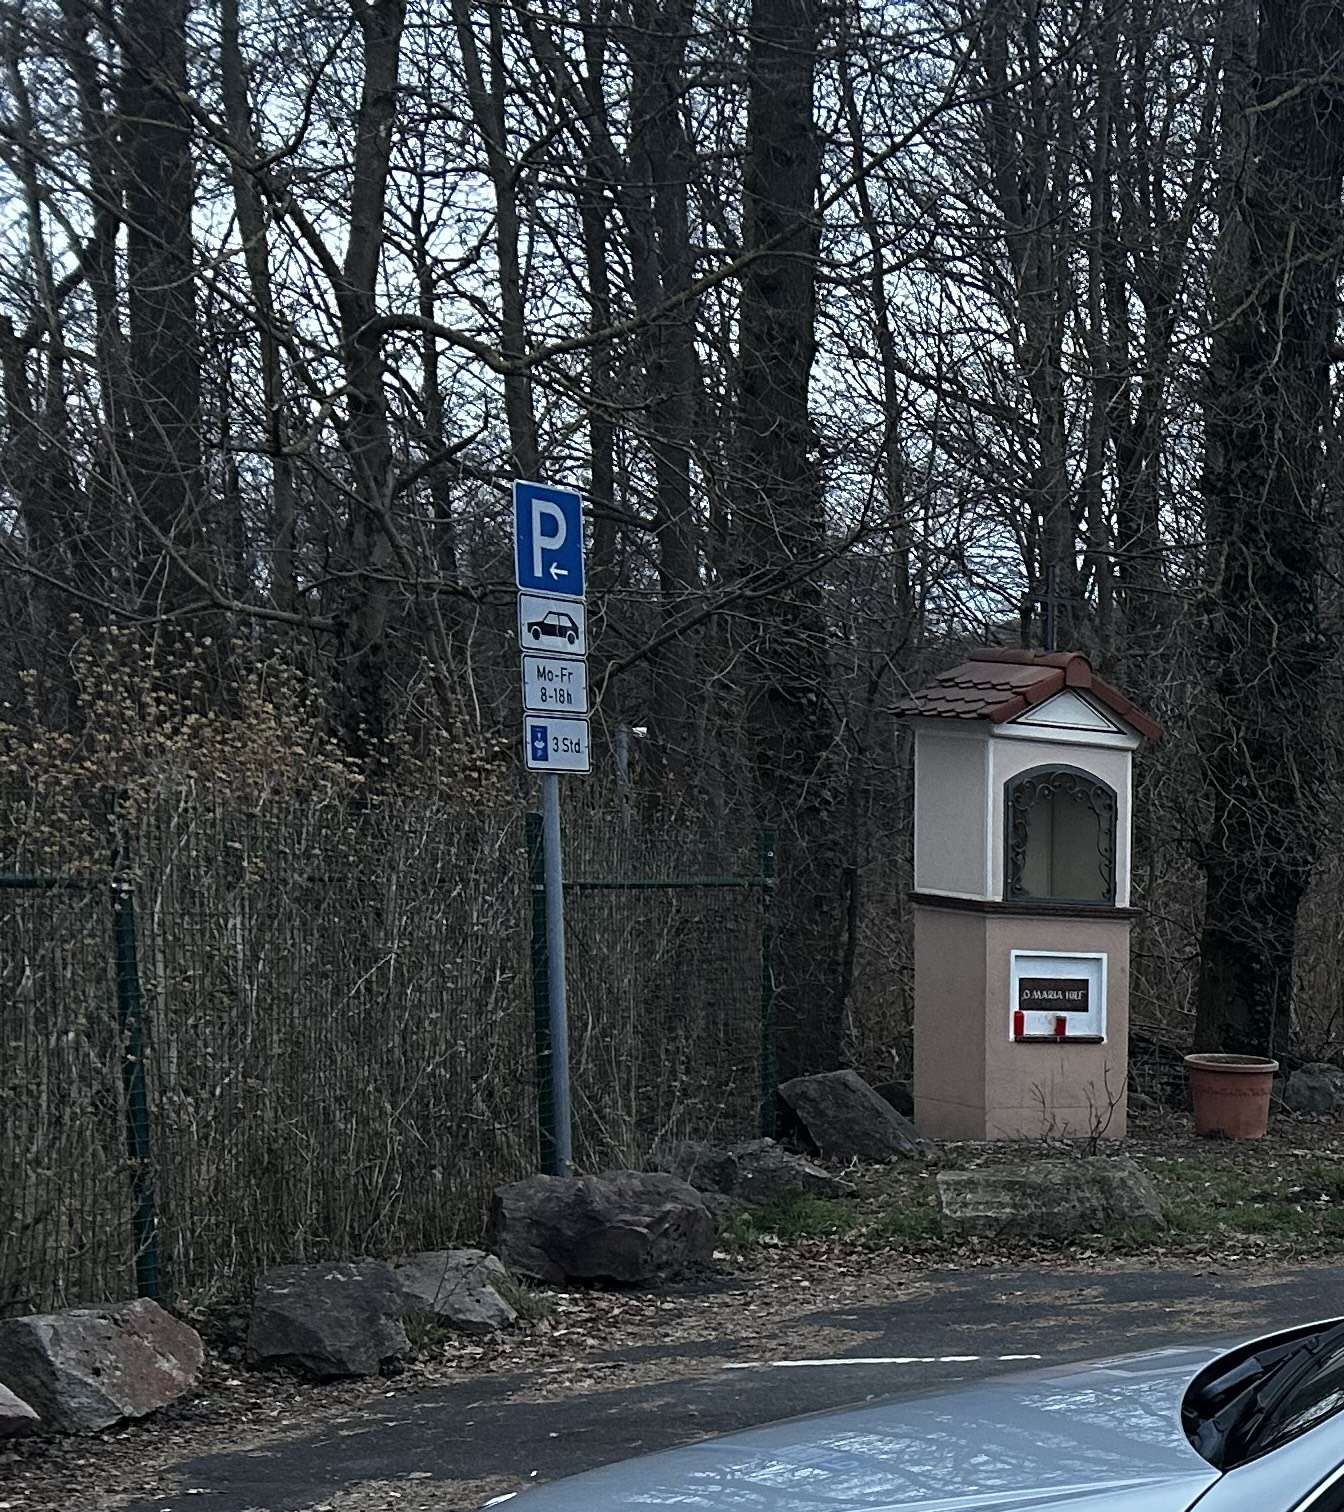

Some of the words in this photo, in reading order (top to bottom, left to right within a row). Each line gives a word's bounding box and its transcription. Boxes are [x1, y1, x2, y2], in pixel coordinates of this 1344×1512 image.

[531, 498, 567, 577] P
[536, 665, 574, 683] Mo-Fr
[552, 736, 559, 753] 3
